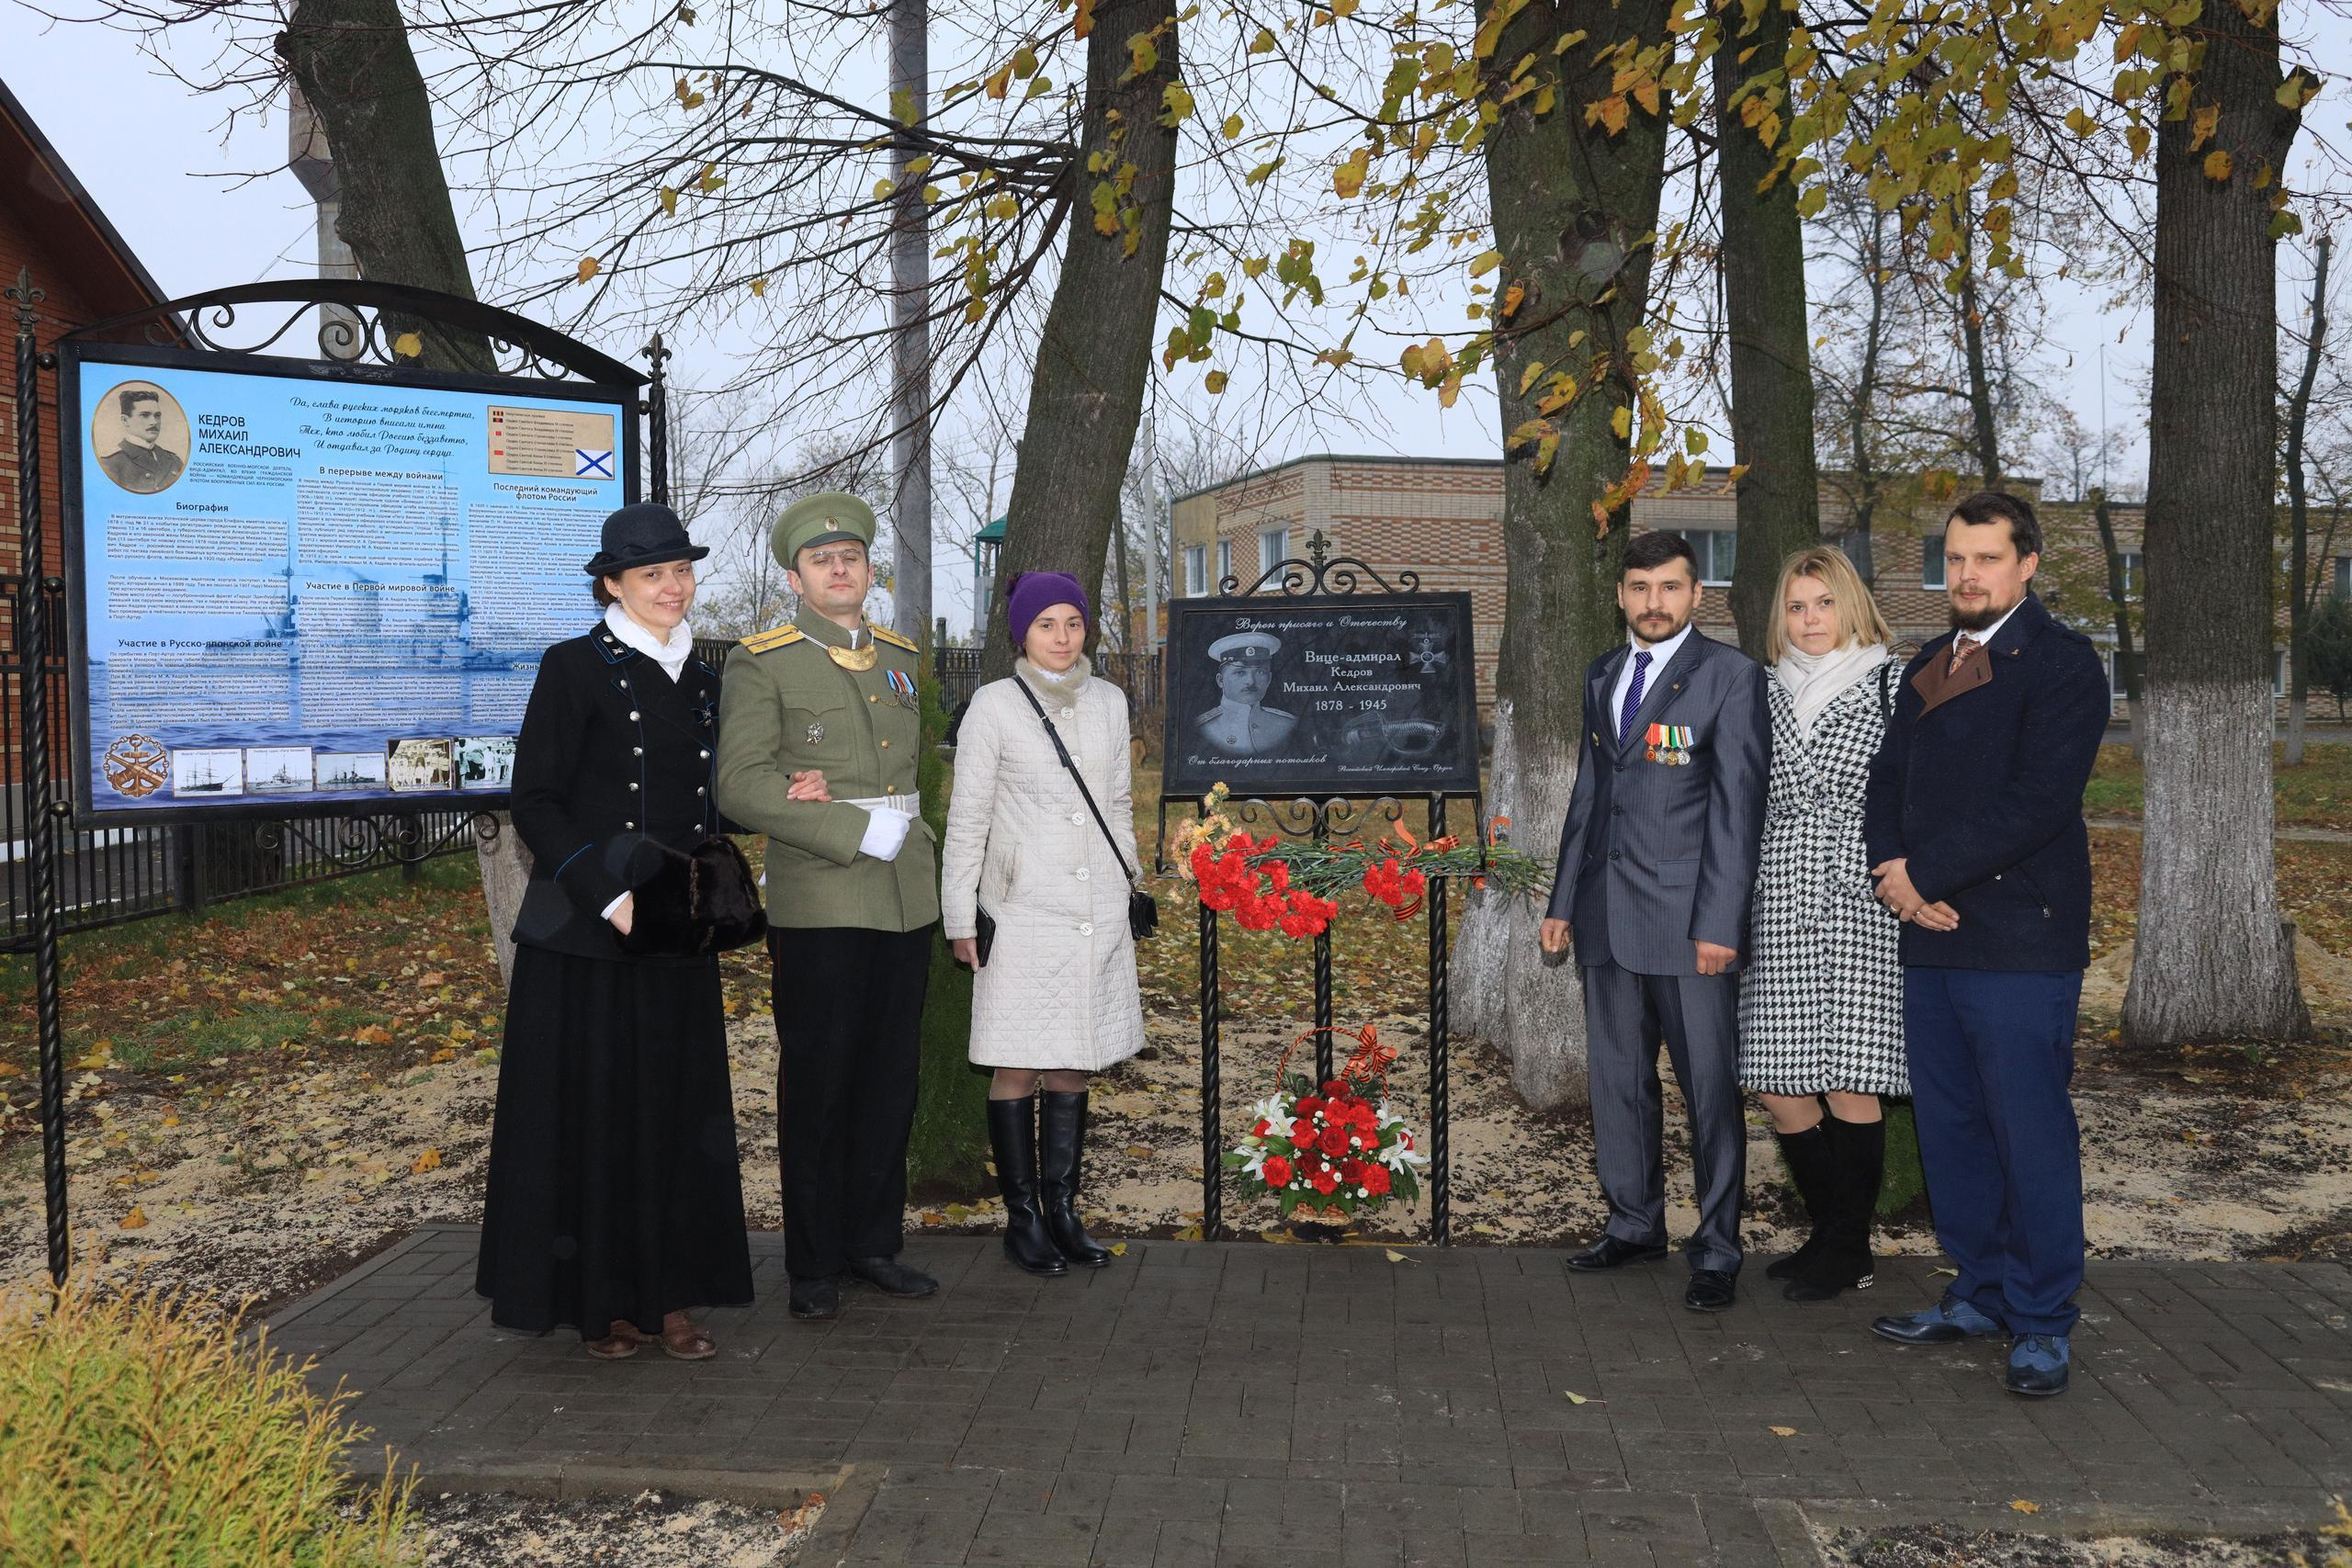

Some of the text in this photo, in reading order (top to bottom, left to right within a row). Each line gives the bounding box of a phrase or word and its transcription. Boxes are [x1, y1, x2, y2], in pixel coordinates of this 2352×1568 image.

[290, 397, 475, 419] Да, слава русских моряков бессмертна,
[198, 414, 245, 427] КЕДРОВ
[323, 413, 332, 422] В
[335, 416, 376, 426] историю
[380, 416, 416, 428] вписали
[199, 429, 248, 441] МИХАИЛ
[299, 425, 468, 445] Тех, кто любил Россию беззаветно,
[199, 443, 301, 458] АЛЕКСАНДРОВИЧ
[314, 440, 326, 449] И
[327, 443, 368, 452] отдавал
[370, 446, 381, 454] за
[384, 444, 421, 456] Родину
[328, 468, 372, 478] перерыве
[375, 470, 403, 480] между
[406, 471, 443, 480] войнами
[494, 483, 597, 495] Последний командующий
[176, 502, 229, 512] Биография
[306, 582, 342, 591] Участие
[353, 582, 386, 592] Первой
[388, 584, 427, 593] мировой
[1235, 617, 1275, 632] Верен
[1339, 615, 1407, 630] Отечеству
[118, 639, 157, 648] Участие
[170, 639, 251, 648] Русско-японской
[1304, 651, 1402, 664] Вице-адмирал
[1331, 667, 1373, 678] Кедров
[1283, 681, 1421, 693] Михаил Александрович
[1315, 700, 1343, 711] 1878
[1359, 699, 1387, 710] 1945
[1188, 754, 1327, 767] От благодарных потомков
